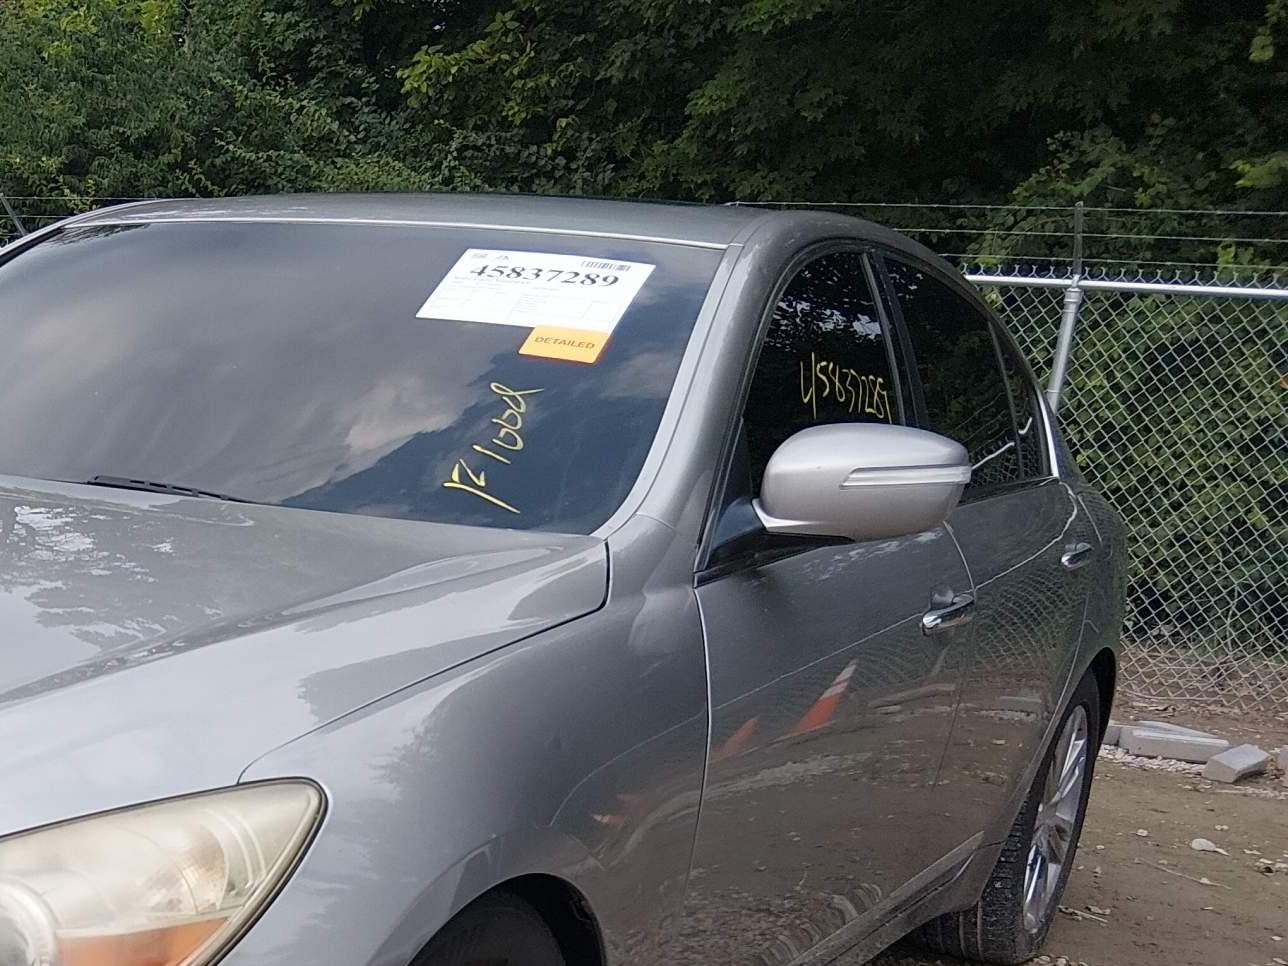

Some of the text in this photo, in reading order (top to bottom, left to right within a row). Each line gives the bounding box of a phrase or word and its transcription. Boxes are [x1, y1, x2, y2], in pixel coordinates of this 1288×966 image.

[469, 264, 620, 288] 45837289
[534, 336, 596, 350] DETAILED
[800, 352, 892, 424] 45837289
